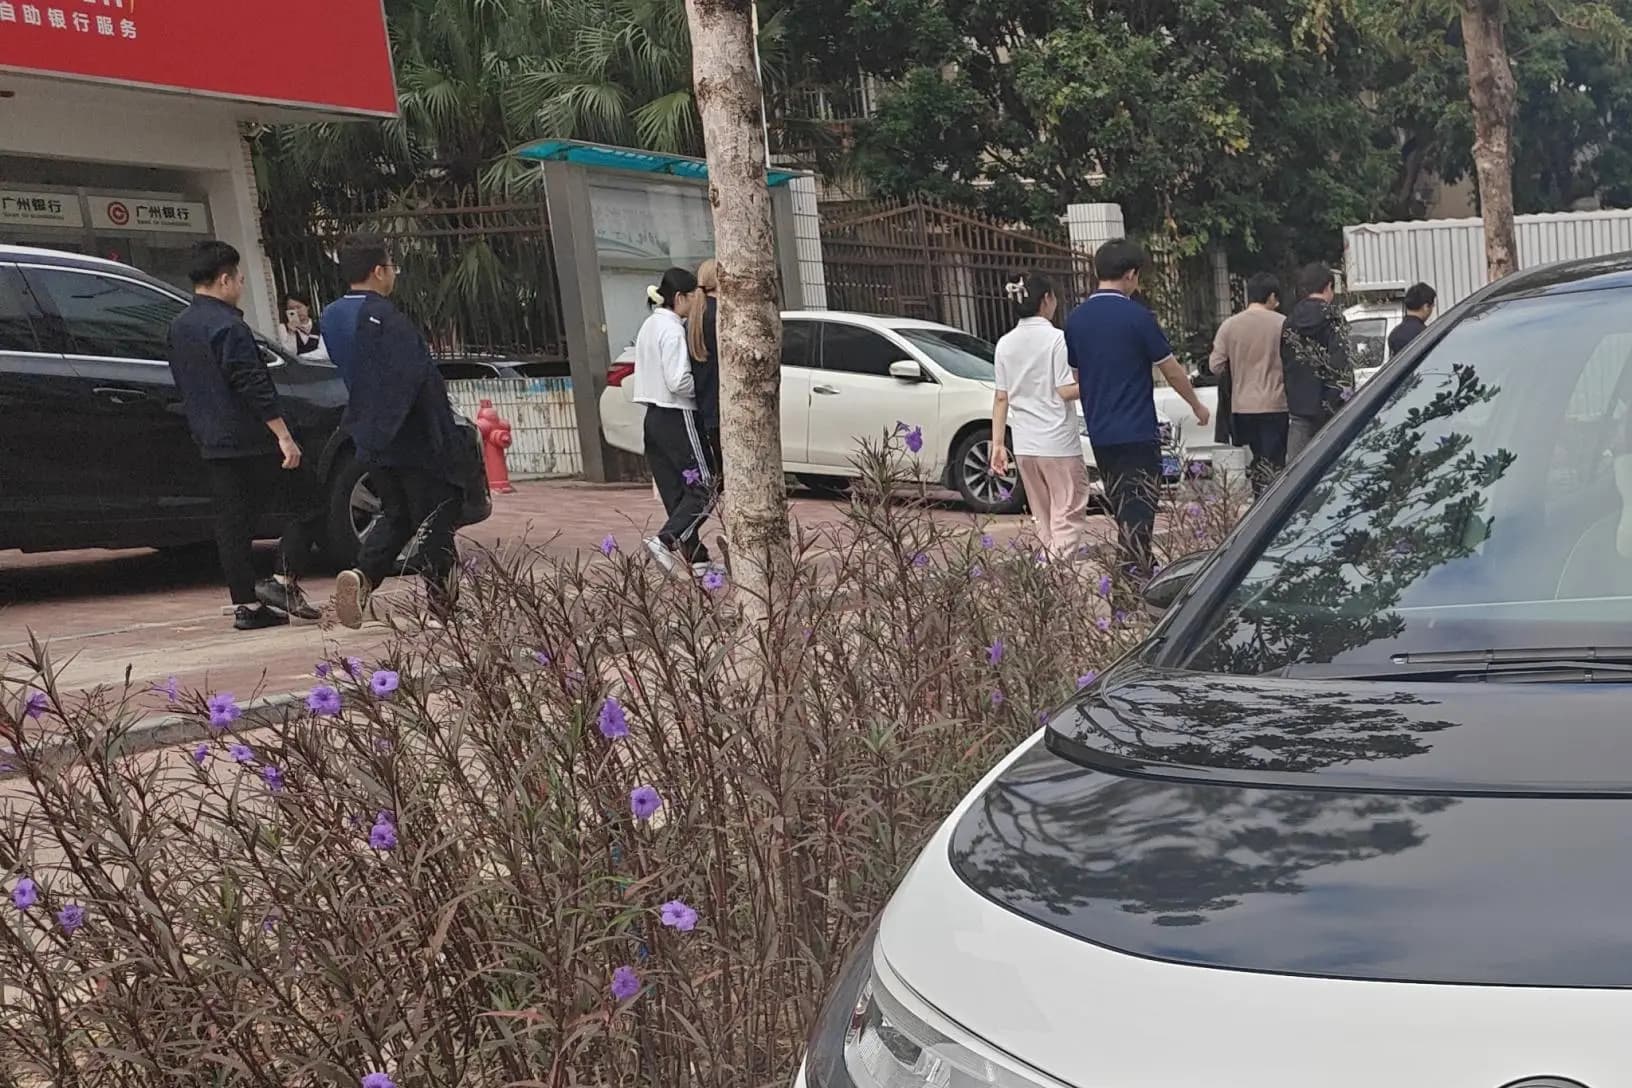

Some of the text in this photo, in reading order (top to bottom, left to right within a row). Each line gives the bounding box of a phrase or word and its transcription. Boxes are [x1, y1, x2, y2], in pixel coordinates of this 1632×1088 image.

[0, 1, 137, 39] 自助银行服务
[2, 196, 62, 213] 广州银行
[136, 205, 190, 220] 广州银行
